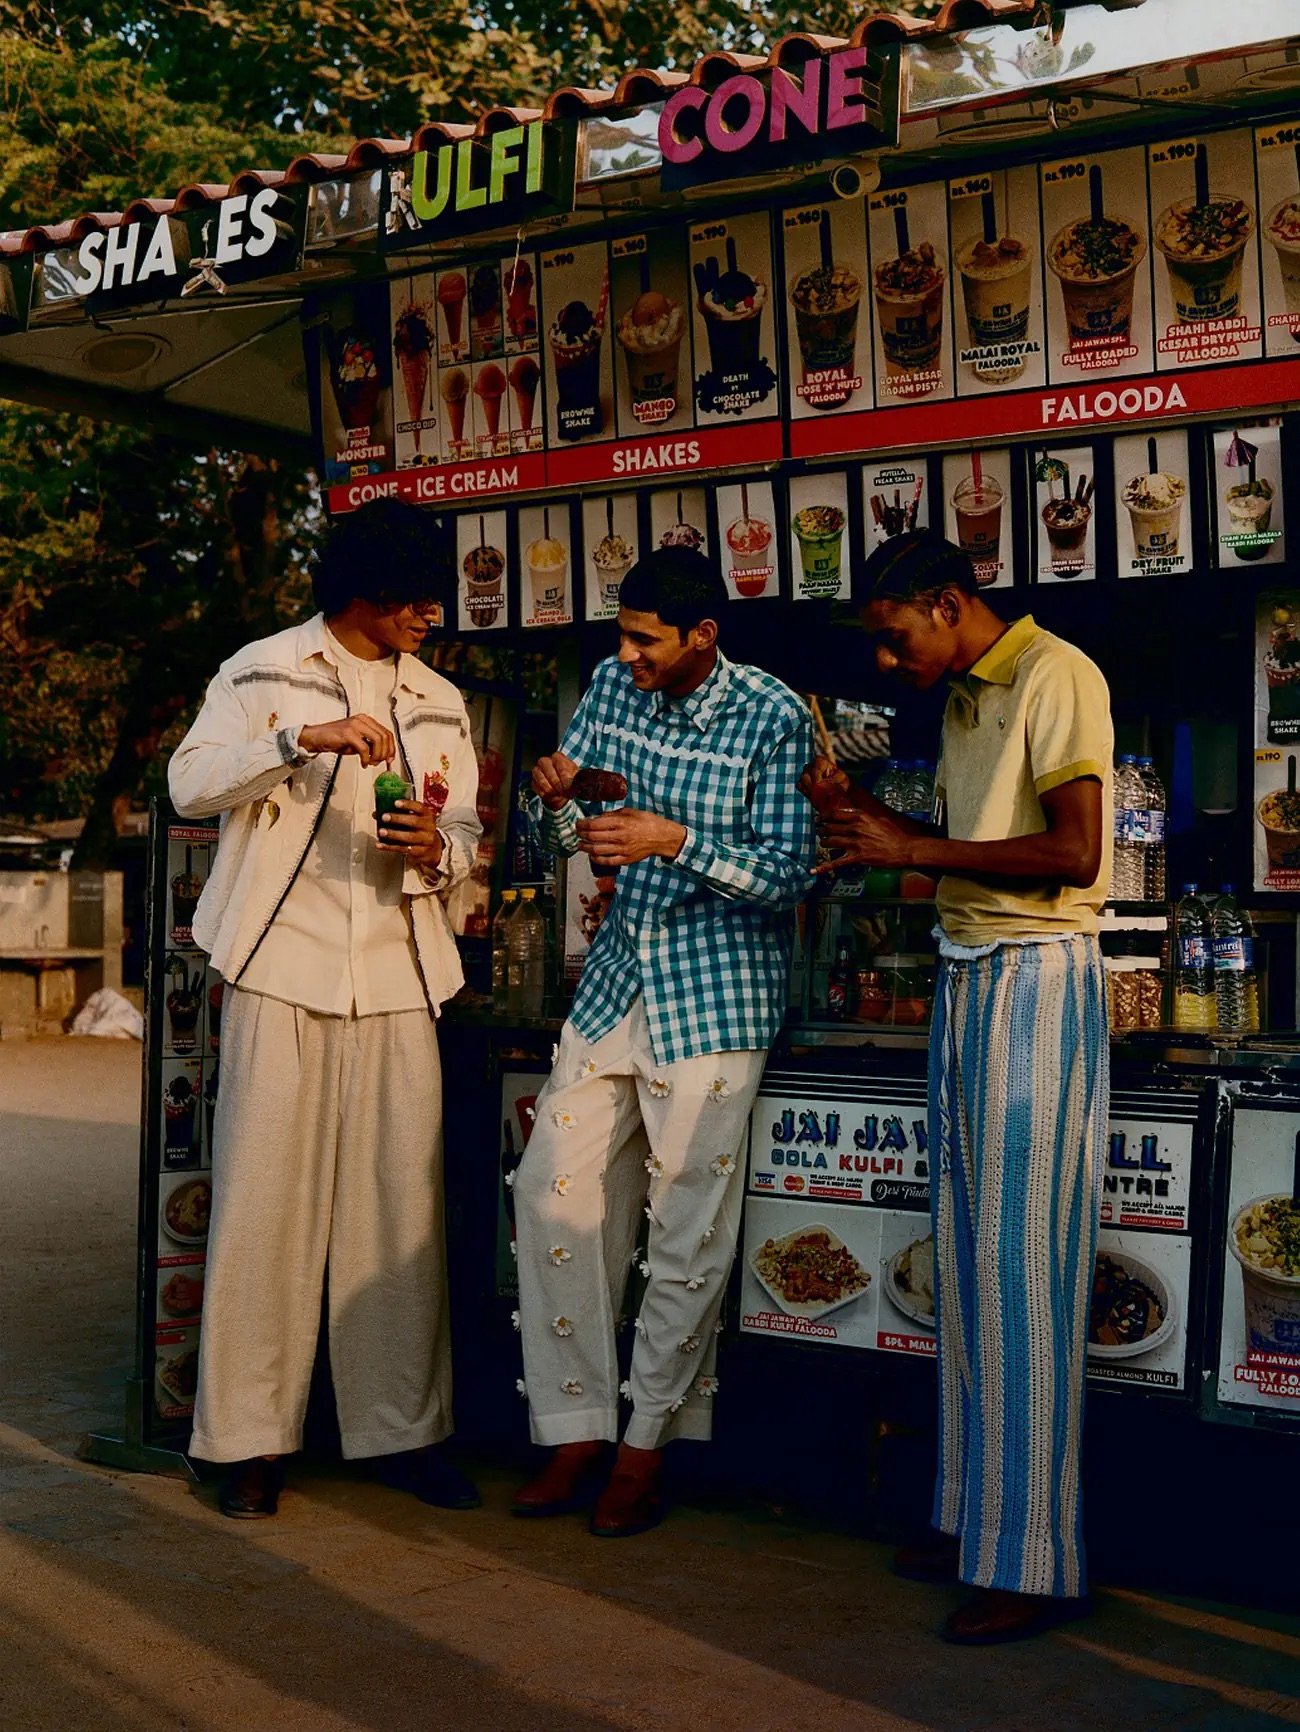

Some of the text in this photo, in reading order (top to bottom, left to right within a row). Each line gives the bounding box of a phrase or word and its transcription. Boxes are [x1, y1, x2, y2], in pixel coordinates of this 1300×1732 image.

[658, 48, 868, 165] CONE
[75, 188, 279, 296] SHAES
[1168, 318, 1246, 338] SHAHI RABDI
[961, 342, 1040, 362] MALAI ROYAL
[1159, 338, 1198, 352] KESAR
[1063, 346, 1137, 366] FULLY LOADED
[1178, 345, 1237, 362] FALOODA
[978, 356, 1021, 370] FALOODA
[1081, 358, 1118, 369] FALOODA
[722, 373, 748, 384] DEATH
[806, 370, 847, 384] ROYAL
[797, 384, 822, 396] ROSE
[837, 379, 861, 391] NUTS
[712, 391, 760, 404] CHOCOLATE
[809, 392, 846, 403] FALOODA
[1041, 383, 1187, 424] FALOODA
[634, 399, 674, 414] MANGO
[565, 417, 591, 428] SHAKE
[350, 437, 369, 447] PINK
[336, 446, 387, 463] MONSTER
[612, 441, 701, 473] SHAKES
[416, 476, 446, 498] ICE
[450, 465, 519, 493] CREAM
[1132, 556, 1185, 569] DRY FRUIT
[729, 567, 774, 578] STRAWBERRY
[1146, 566, 1171, 574] SHAKE
[465, 594, 504, 604] CHOCOLATE
[1274, 726, 1298, 734] SHAKE
[772, 1108, 840, 1146] JAI
[839, 1154, 903, 1175] KULFI
[1102, 1174, 1169, 1196] NTRE
[770, 1320, 794, 1333] KULFI
[795, 1324, 836, 1338] FALOODA
[885, 1338, 904, 1348] SPL.
[1249, 1353, 1264, 1364] JAI
[1146, 1373, 1174, 1385] KULFI
[1235, 1368, 1276, 1384] FULLY
